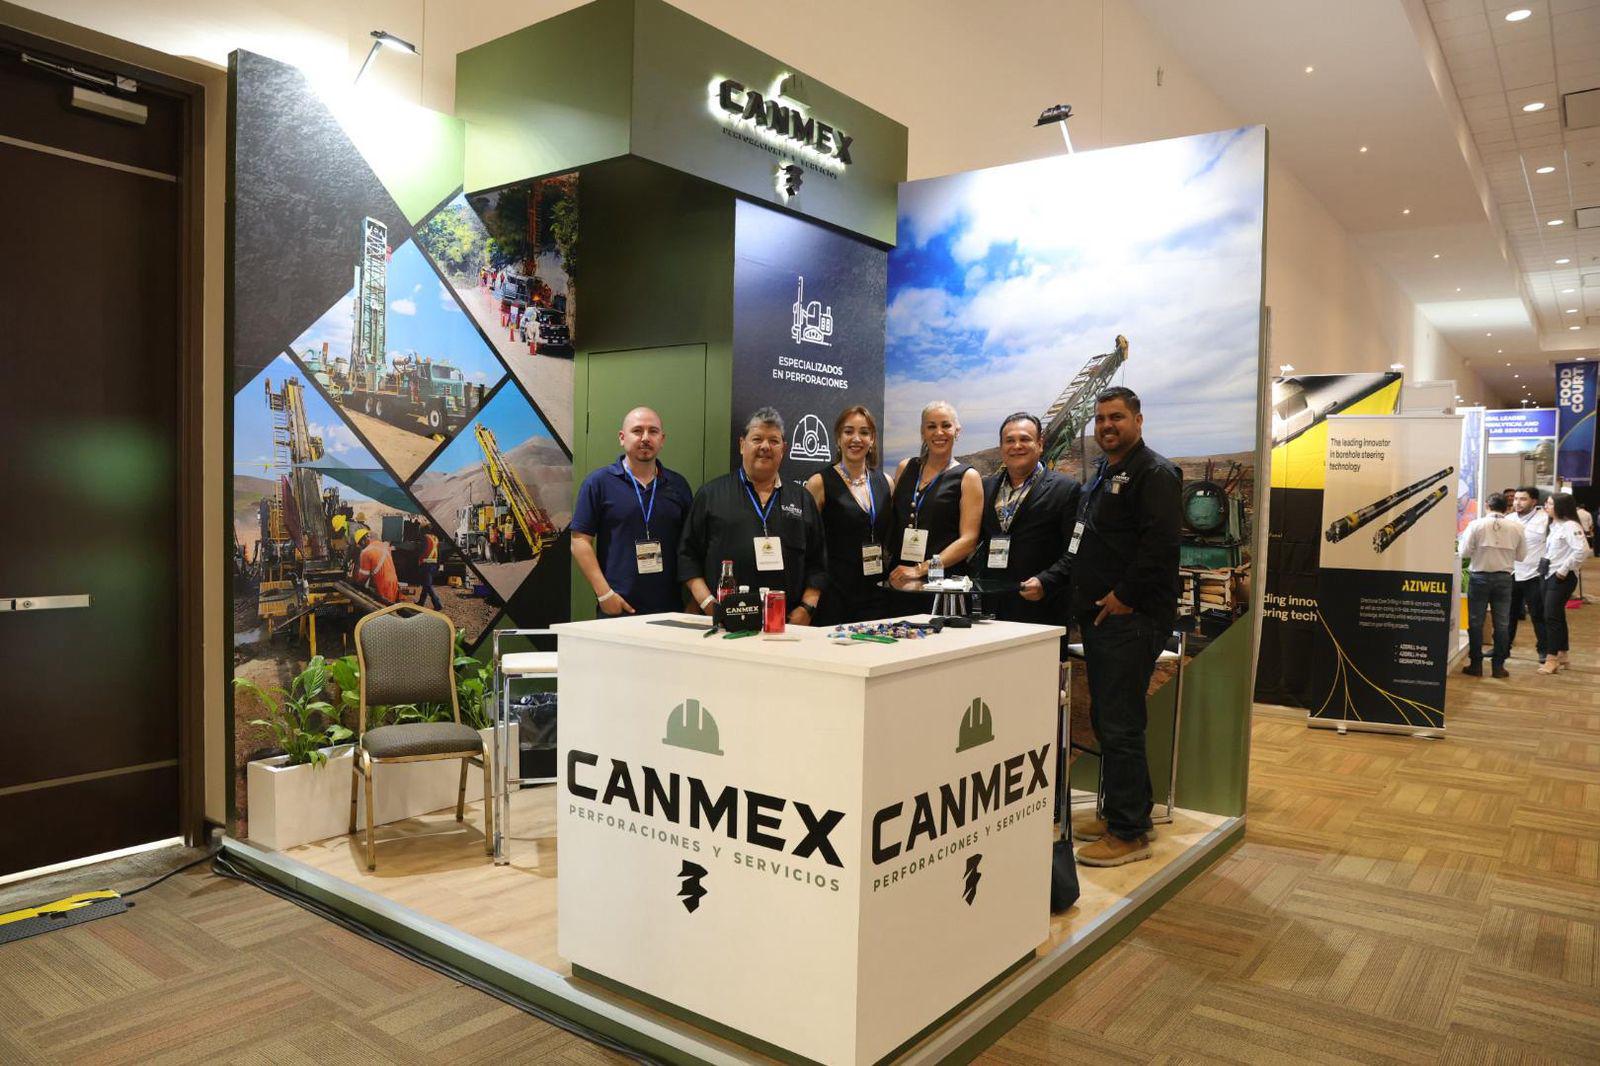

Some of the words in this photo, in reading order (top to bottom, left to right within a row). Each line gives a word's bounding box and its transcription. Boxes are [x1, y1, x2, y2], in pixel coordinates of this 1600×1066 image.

[719, 79, 853, 165] CANMEX
[772, 369, 784, 380] EN
[785, 370, 848, 389] PERFORACIONES
[778, 356, 843, 376] ESPECIALIZADOS
[1560, 368, 1572, 406] FOOD
[1571, 367, 1584, 413] COURT
[1330, 450, 1335, 459] in
[1336, 450, 1360, 459] borehole
[1361, 450, 1385, 461] steering
[1331, 437, 1341, 446] The
[1342, 438, 1362, 449] leading
[1363, 438, 1391, 447] innovator
[1329, 461, 1360, 473] technology
[1401, 579, 1448, 594] AZIWELL
[725, 605, 759, 614] CANMEX
[567, 749, 846, 868] CANMEX
[871, 743, 1052, 865] CANMEX
[568, 803, 701, 853] PERFORACIONES
[712, 845, 722, 858] Y
[733, 852, 840, 892] SERVICIOS
[873, 831, 979, 892] PERFORACIONES
[985, 826, 991, 837] Y
[996, 797, 1047, 832] SERVICIOS
